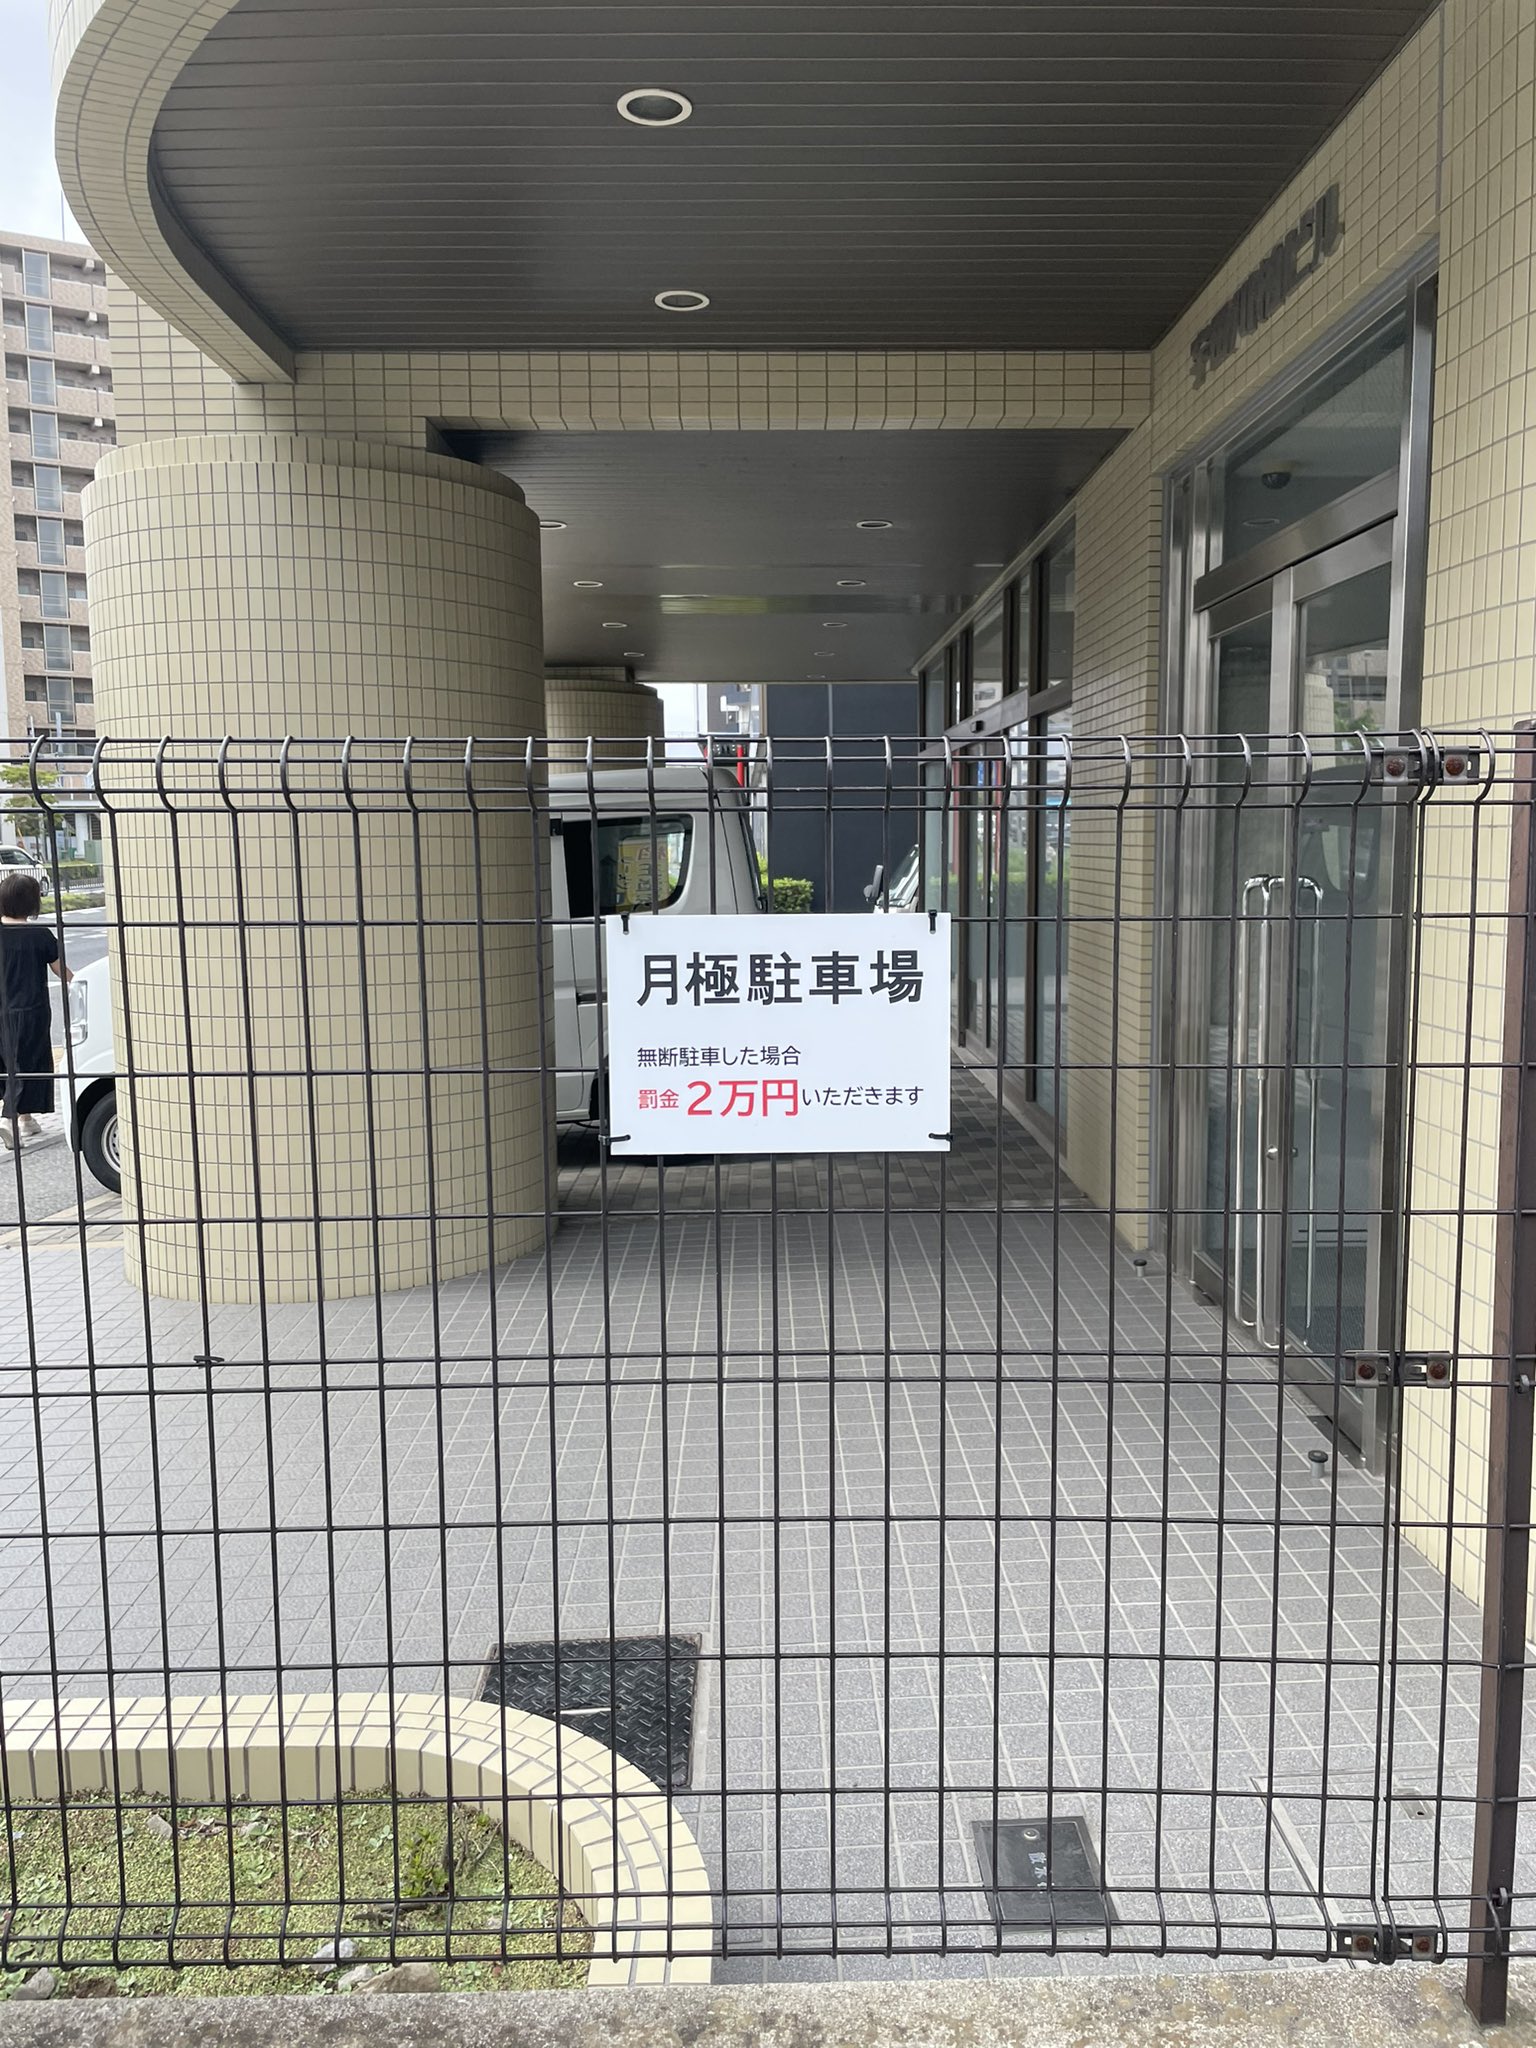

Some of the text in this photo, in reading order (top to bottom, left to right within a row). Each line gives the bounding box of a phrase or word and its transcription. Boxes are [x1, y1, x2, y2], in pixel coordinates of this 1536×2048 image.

[637, 950, 924, 1007] 月極駐車場
[637, 1045, 801, 1068] 無断駐車した場合
